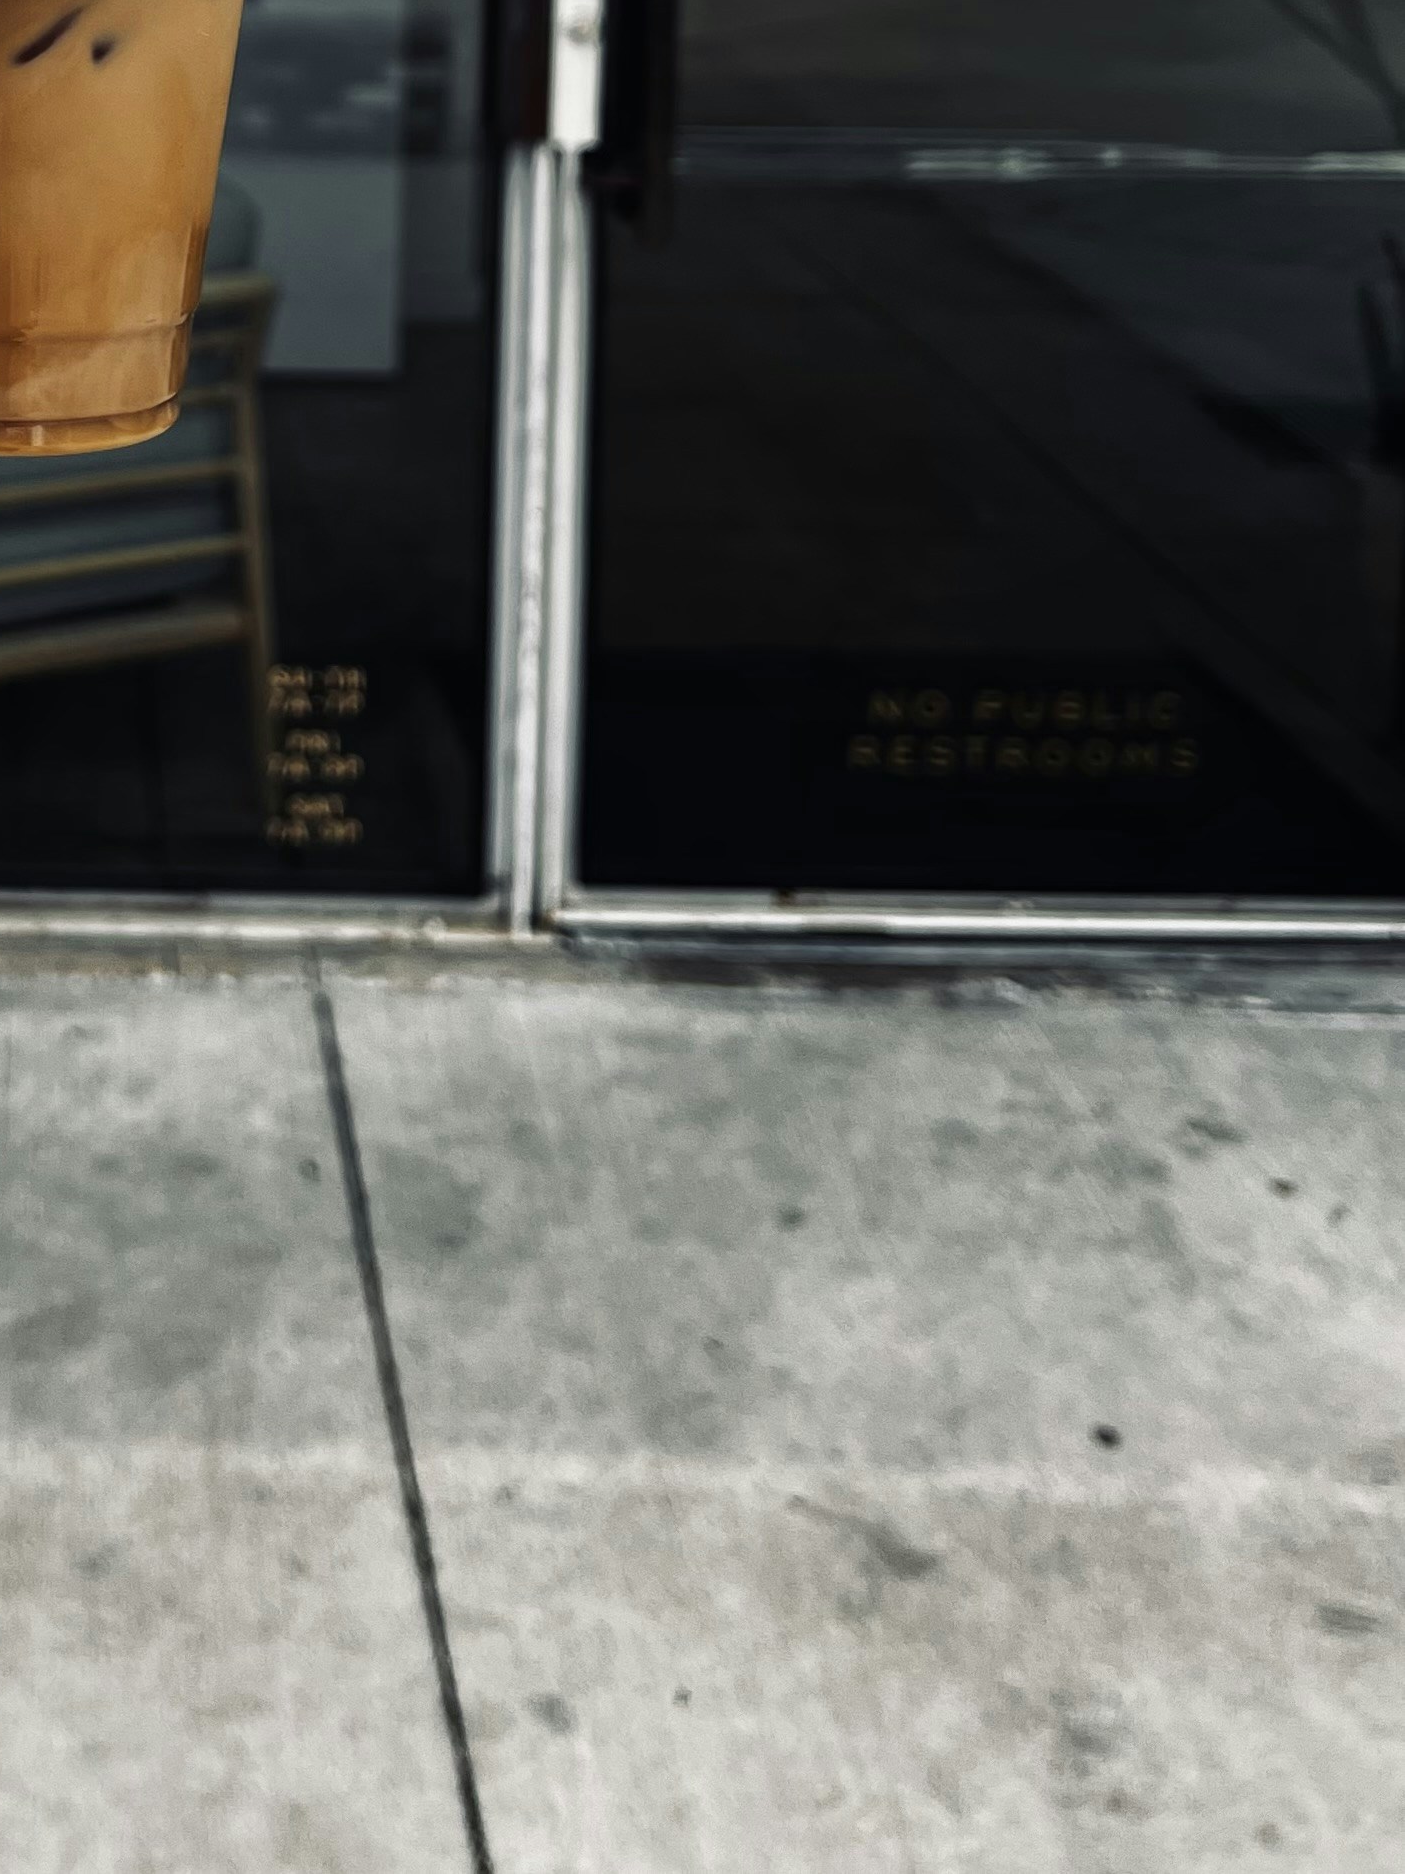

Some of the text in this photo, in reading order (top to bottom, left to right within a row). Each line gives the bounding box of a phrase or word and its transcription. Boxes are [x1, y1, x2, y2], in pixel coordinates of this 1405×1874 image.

[868, 687, 1186, 730] NO PUBLIC
[846, 734, 1200, 777] RESTROOMS
